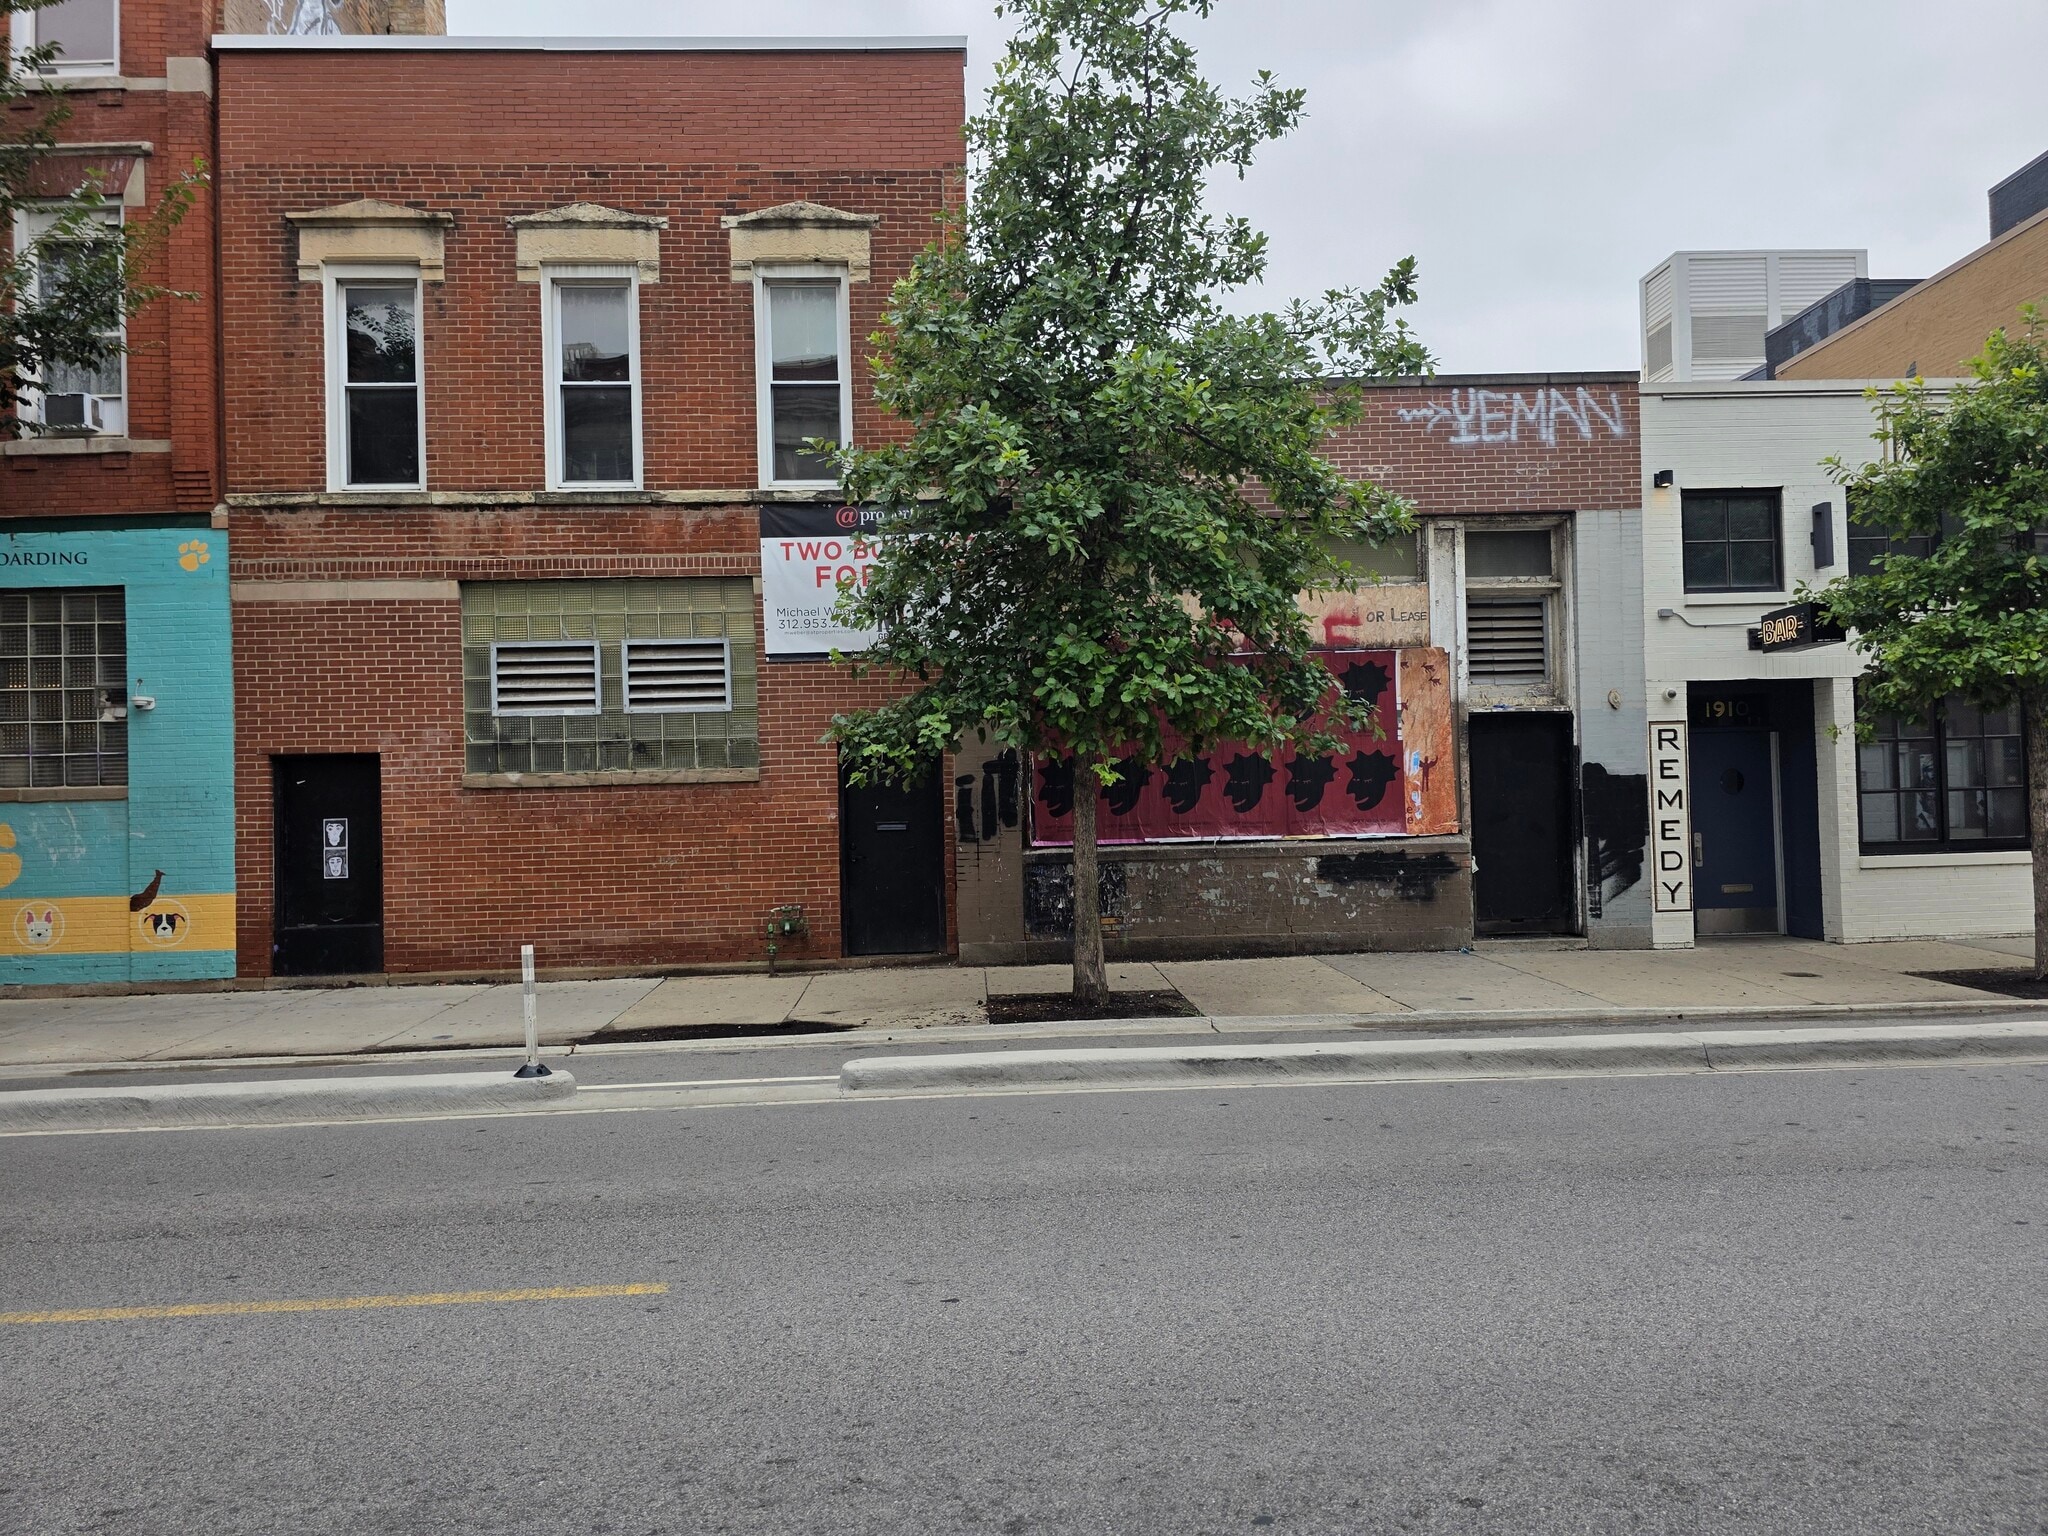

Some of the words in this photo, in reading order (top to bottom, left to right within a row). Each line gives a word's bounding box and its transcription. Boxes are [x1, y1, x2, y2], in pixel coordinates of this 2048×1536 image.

[780, 541, 842, 561] TWO
[776, 607, 820, 618] Michael
[1366, 610, 1385, 623] OR
[1762, 614, 1798, 645] BAR
[1705, 700, 1749, 718] 1910
[1657, 728, 1683, 904] REMEDY
